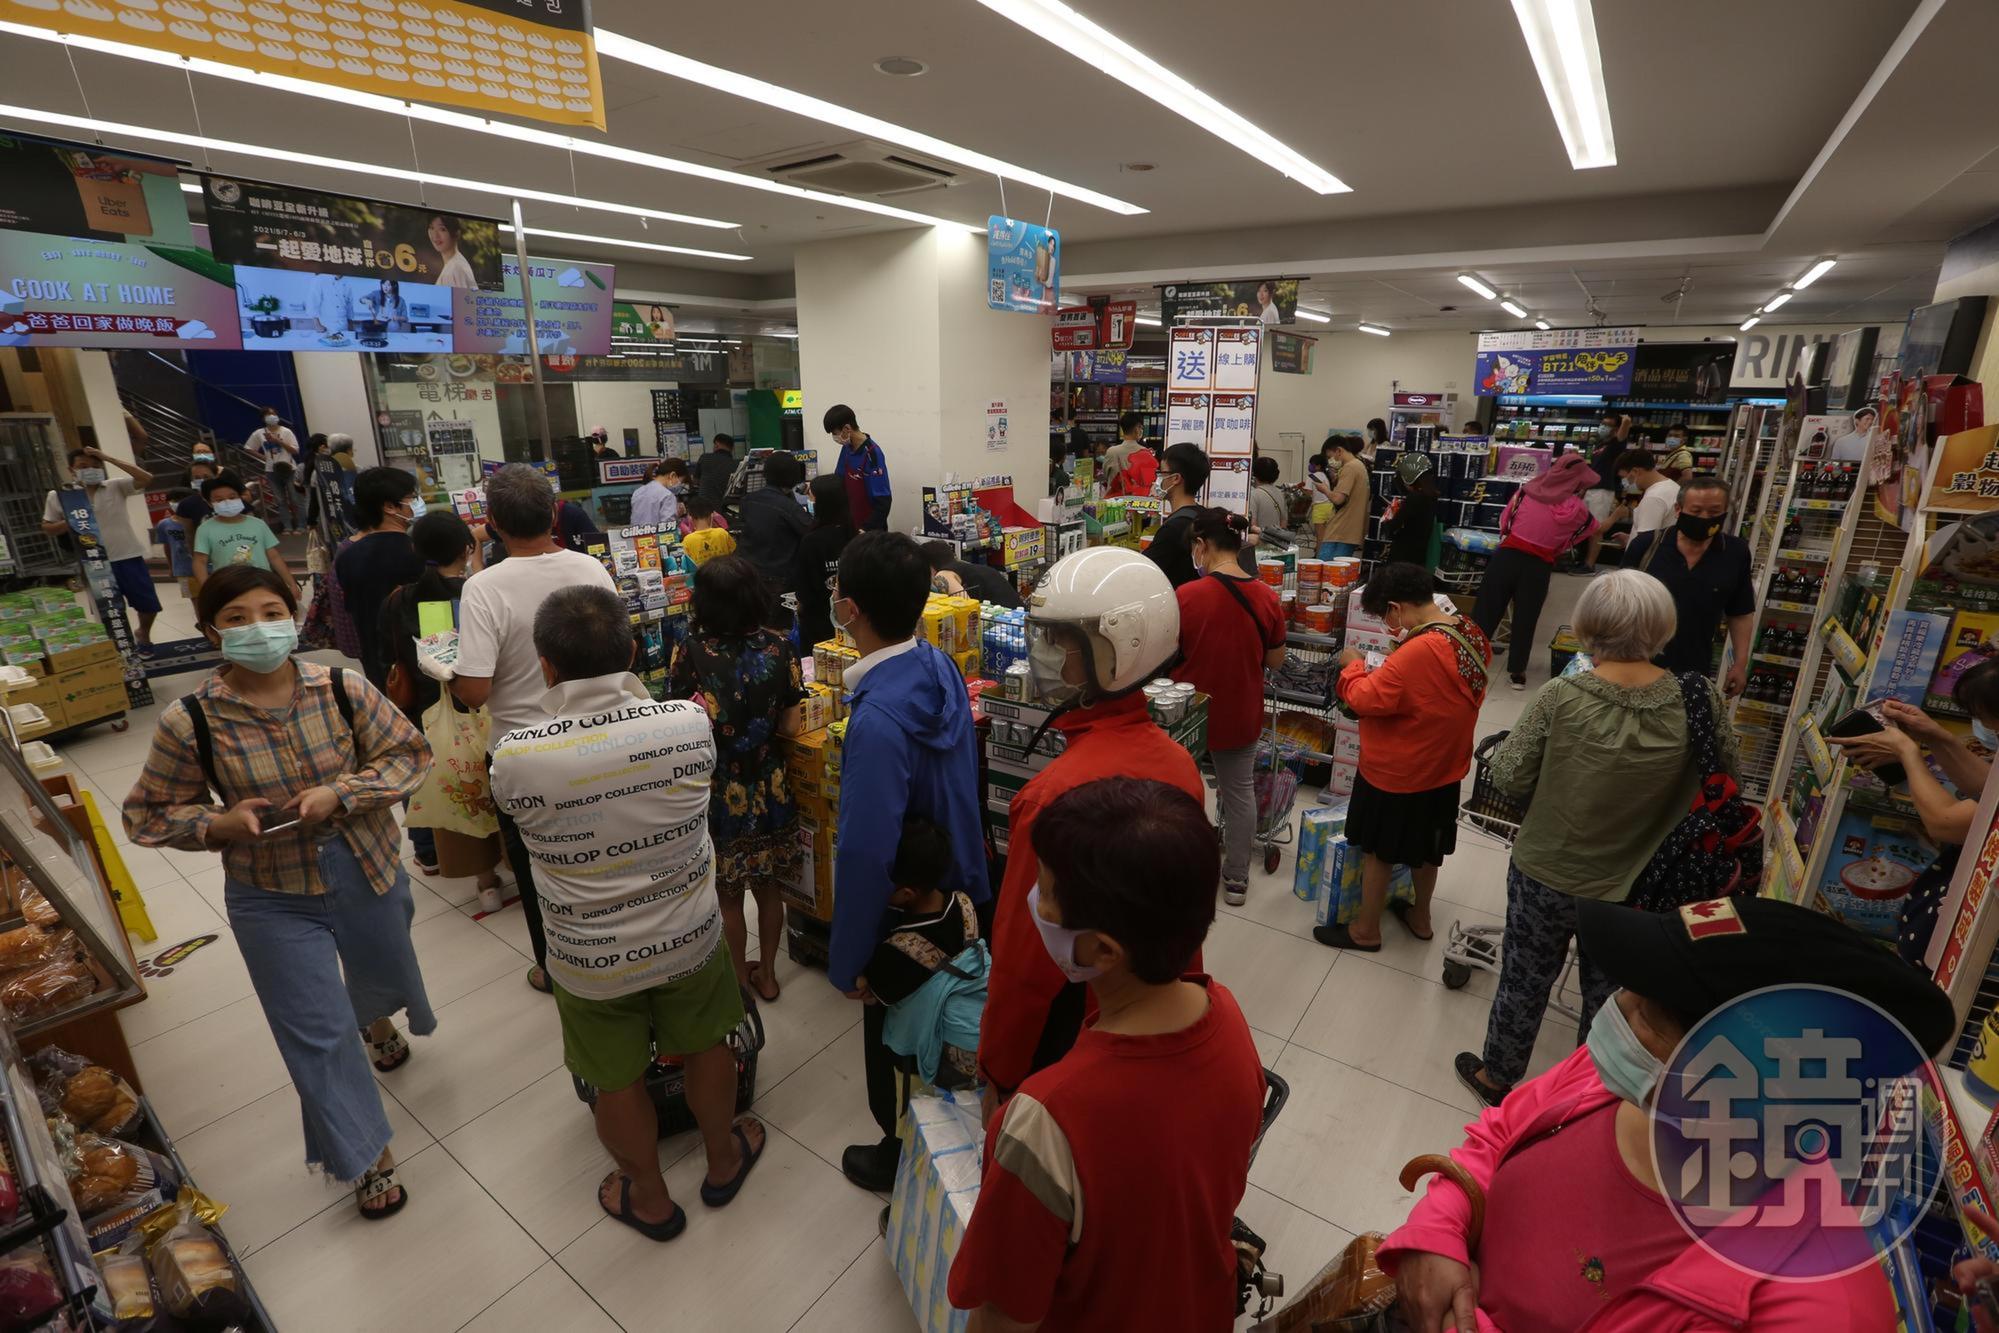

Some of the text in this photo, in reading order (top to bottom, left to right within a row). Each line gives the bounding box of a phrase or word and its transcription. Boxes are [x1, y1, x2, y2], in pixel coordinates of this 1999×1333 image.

[98, 195, 126, 207] Uber
[101, 206, 130, 218] Eats
[256, 238, 363, 267] 一起愛地球
[394, 243, 417, 273] 6
[11, 277, 176, 306] COOK AT HOME
[26, 312, 176, 333] 爸爸回家做晚飯
[1177, 350, 1206, 380] 送
[1218, 353, 1256, 366] 線上購
[1542, 361, 1576, 373] BT21
[417, 382, 466, 402] 電梯
[1214, 417, 1251, 431] 買咖啡
[610, 463, 656, 477] 自助裝袋
[621, 523, 656, 538] Gillette
[504, 703, 687, 743] DUNLOP COLLECTION
[629, 747, 674, 763] DUNLOP
[555, 778, 673, 811] DUNLOP COLLECTION
[531, 830, 595, 844] COLLECTION
[605, 813, 706, 858] COLLECTION
[582, 883, 689, 920] DUNLOP COLLECTION
[557, 933, 617, 947] COLLECTION
[557, 911, 717, 970] DUNLOP COLLECTION
